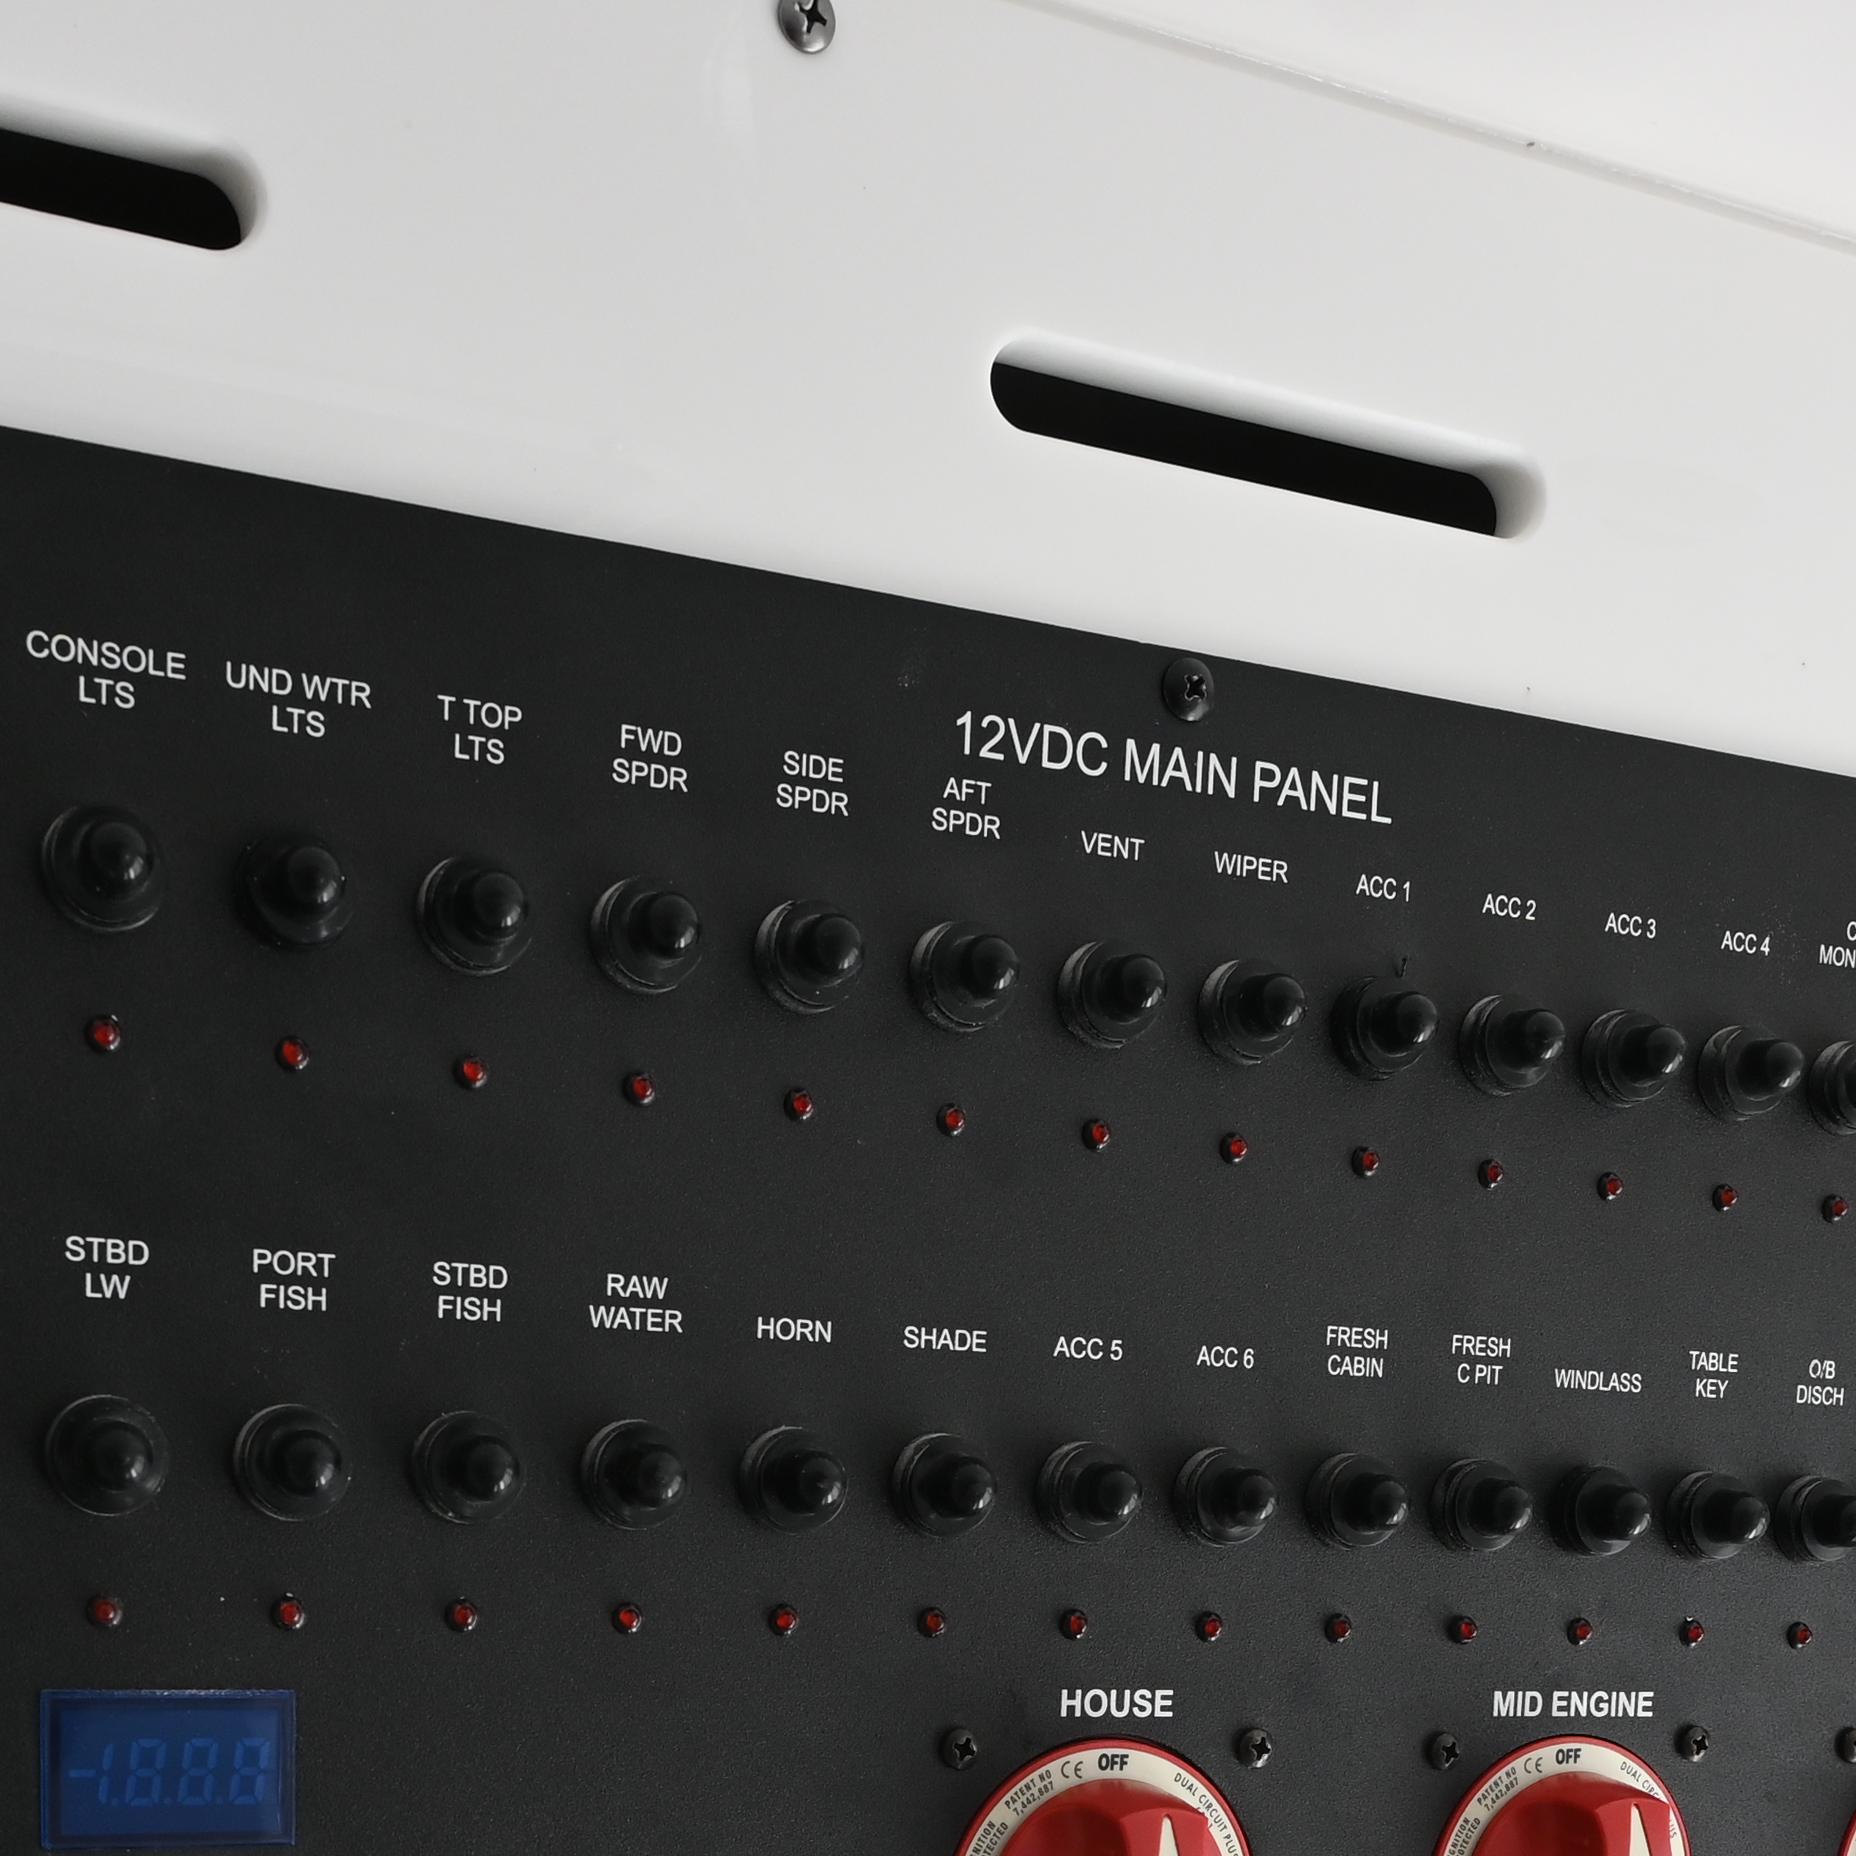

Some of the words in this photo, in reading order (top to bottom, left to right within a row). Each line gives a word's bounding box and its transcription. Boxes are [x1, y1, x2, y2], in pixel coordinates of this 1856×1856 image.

[26, 630, 186, 680] CONSOLE
[79, 676, 135, 708] LTS
[226, 661, 292, 695] UND
[302, 673, 371, 708] WTR
[272, 705, 325, 737] LTS
[437, 695, 456, 721] T
[463, 699, 522, 730] TOP
[455, 733, 504, 764] LTS
[621, 724, 682, 756] FWD
[612, 758, 688, 792] SPDR
[783, 751, 844, 782] SIDE
[956, 711, 1108, 776] 12VDC
[1124, 738, 1237, 798] MAIN
[1253, 761, 1392, 824] PANEL
[776, 783, 848, 816] SPDR
[943, 777, 992, 804] AFT
[932, 807, 1000, 839] SPDR
[1081, 830, 1145, 860] VENT
[1215, 851, 1288, 883] WIPER
[1356, 874, 1396, 899] ACC
[1403, 881, 1410, 902] 1
[1482, 894, 1521, 918] ACC
[1525, 900, 1536, 920] 2
[1605, 913, 1642, 936] ACC
[1647, 919, 1656, 938] 3
[1721, 931, 1757, 954] ACC
[1760, 935, 1770, 956] 4
[65, 1236, 149, 1265] STBD
[253, 1249, 336, 1277] PORT
[86, 1273, 131, 1299] LW
[433, 1261, 508, 1289] STBD
[607, 1273, 668, 1299] RAW
[260, 1284, 326, 1311] FISH
[438, 1295, 501, 1322] FISH
[589, 1305, 683, 1333] WATER
[757, 1317, 831, 1343] HORN
[904, 1326, 987, 1352] SHADE
[1053, 1336, 1103, 1360] ACC
[1110, 1340, 1122, 1360] 5
[1327, 1325, 1388, 1349] FRESH
[1452, 1335, 1511, 1357] FRESH
[1197, 1345, 1238, 1367] ACC
[1243, 1348, 1254, 1369] 6
[1328, 1355, 1383, 1378] CABIN
[1689, 1351, 1739, 1372] TABLE
[1809, 1359, 1835, 1379] O/B
[1457, 1363, 1470, 1383] C
[1475, 1364, 1503, 1385] PIT
[1555, 1368, 1642, 1393] WINDLASS
[1696, 1378, 1728, 1398] KEY
[1796, 1385, 1844, 1406] DISCH
[1061, 1689, 1173, 1718] HOUSE
[1493, 1691, 1542, 1717] MID
[1552, 1691, 1654, 1717] ENGINE
[1098, 1754, 1129, 1771] OFF
[1556, 1748, 1582, 1765] OFF
[1174, 1772, 1198, 1797] DUAL
